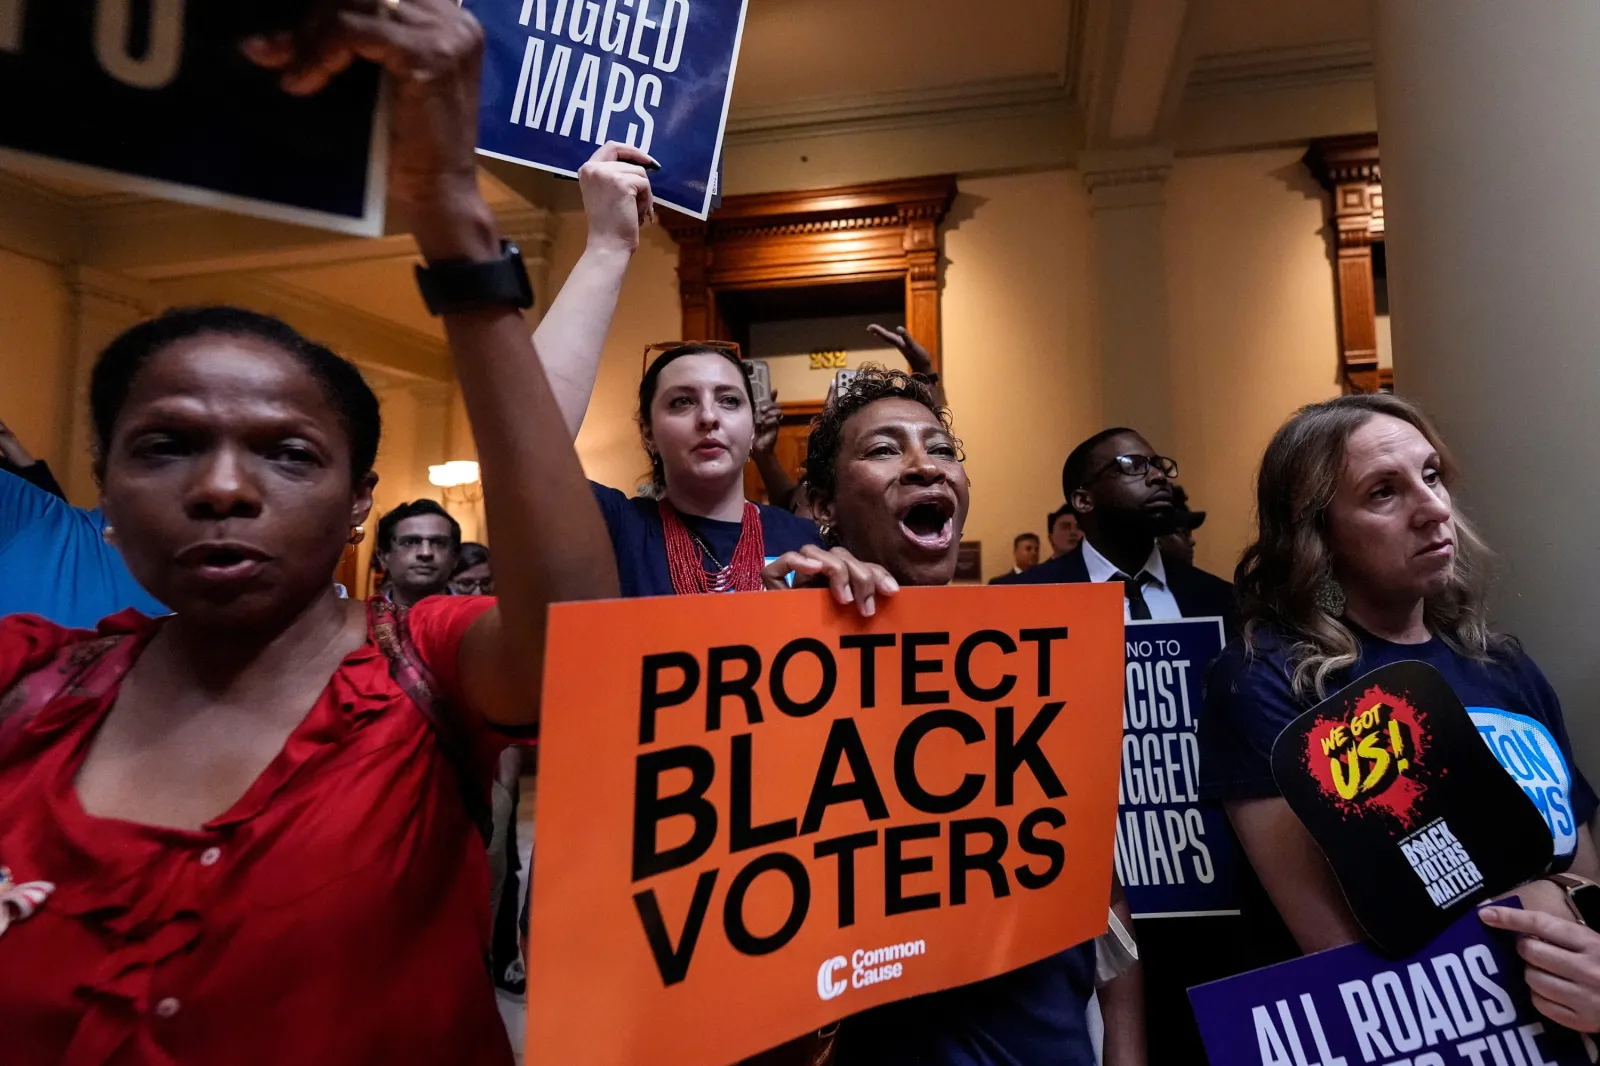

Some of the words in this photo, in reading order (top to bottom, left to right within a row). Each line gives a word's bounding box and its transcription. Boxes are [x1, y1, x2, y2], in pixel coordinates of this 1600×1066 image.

[510, 35, 663, 155] MAPS
[1126, 641, 1152, 658] NO
[1156, 640, 1181, 656] TO
[638, 627, 1068, 745] PROTECT
[1123, 660, 1198, 733] CIST,
[1321, 725, 1349, 756] WE
[1350, 702, 1381, 736] GOT
[1330, 719, 1409, 800] US!
[632, 702, 1068, 883] BLACK
[1119, 732, 1200, 805] GGED
[1114, 808, 1215, 886] MAPS
[1413, 841, 1471, 886] VOTERS
[1425, 860, 1484, 907] MATTER
[633, 808, 1067, 988] VOTERS
[852, 939, 926, 969] Common
[852, 962, 903, 989] Cause
[1251, 993, 1348, 1066] ALL
[1338, 943, 1517, 1063] ROADS
